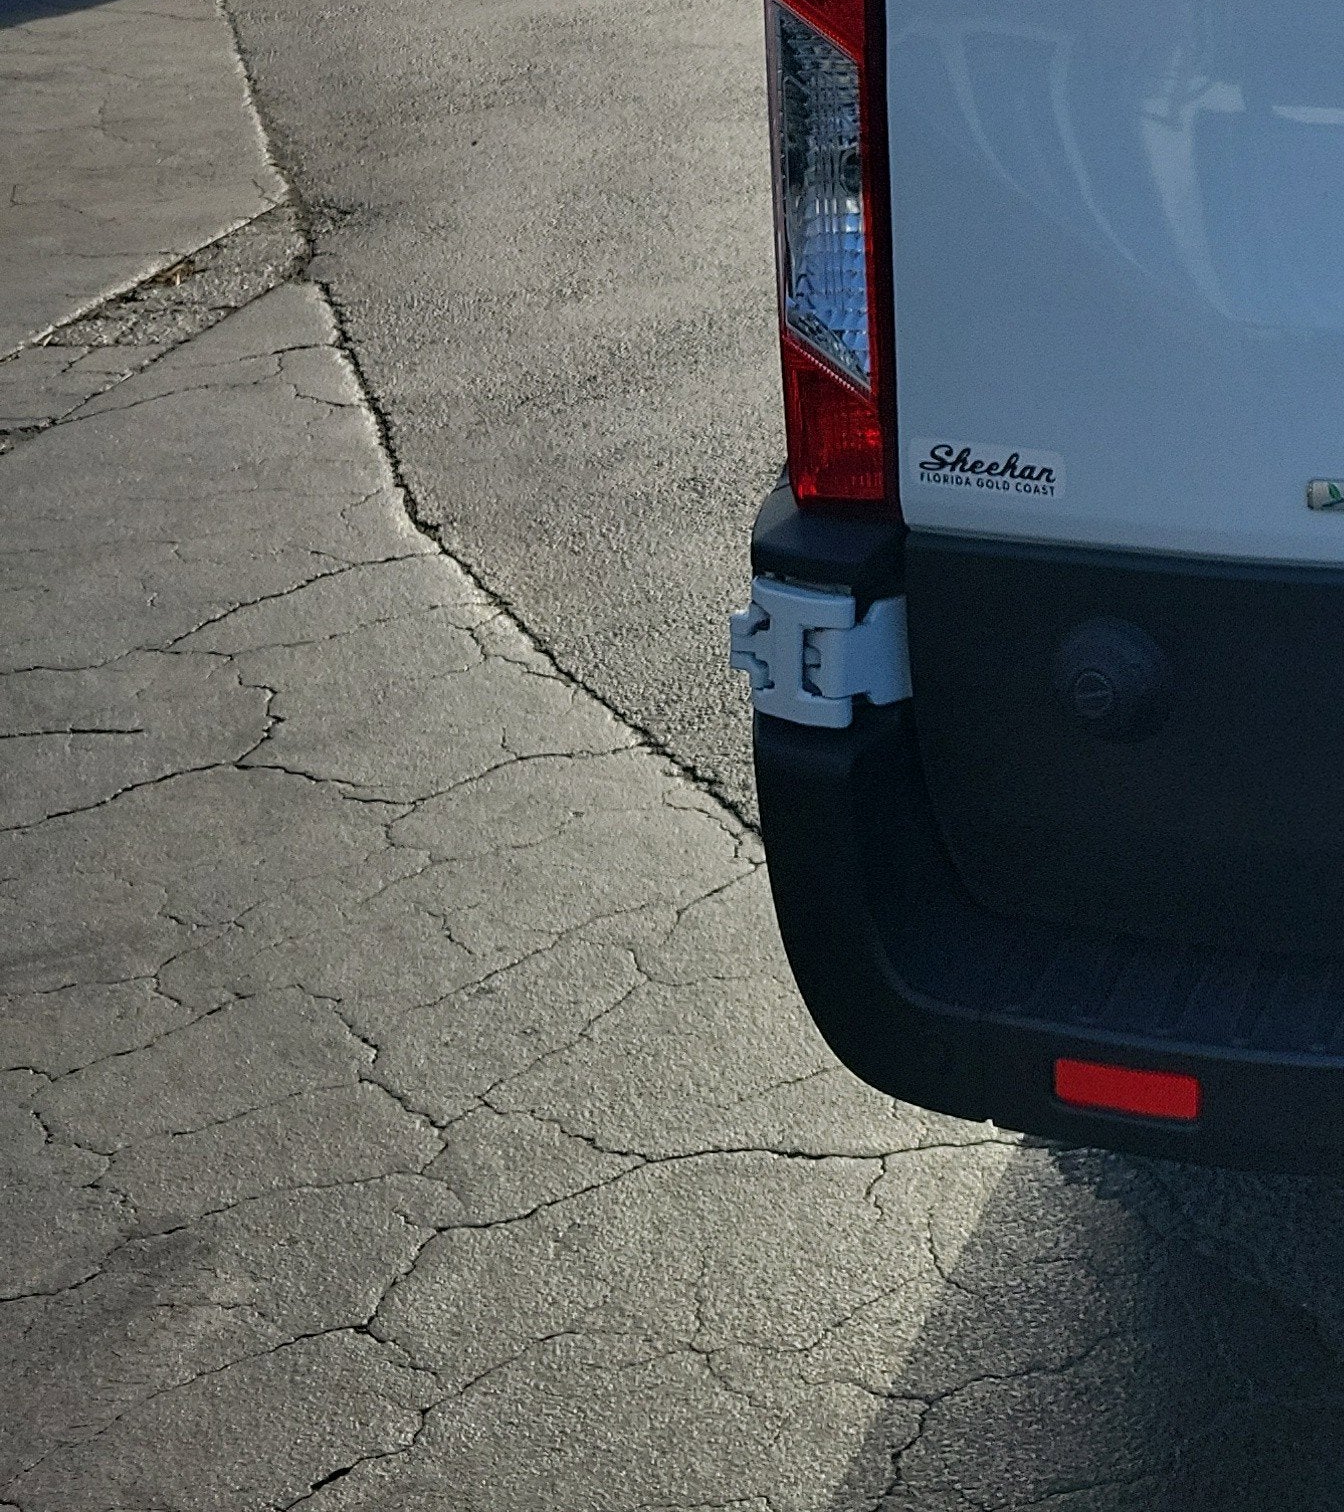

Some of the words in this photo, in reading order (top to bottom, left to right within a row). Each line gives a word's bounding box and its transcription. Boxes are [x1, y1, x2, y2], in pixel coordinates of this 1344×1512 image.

[918, 444, 1056, 484] Sheehan
[919, 472, 972, 486] FLORIDA
[976, 477, 1010, 491] GOLD
[1015, 482, 1056, 497] COAST
